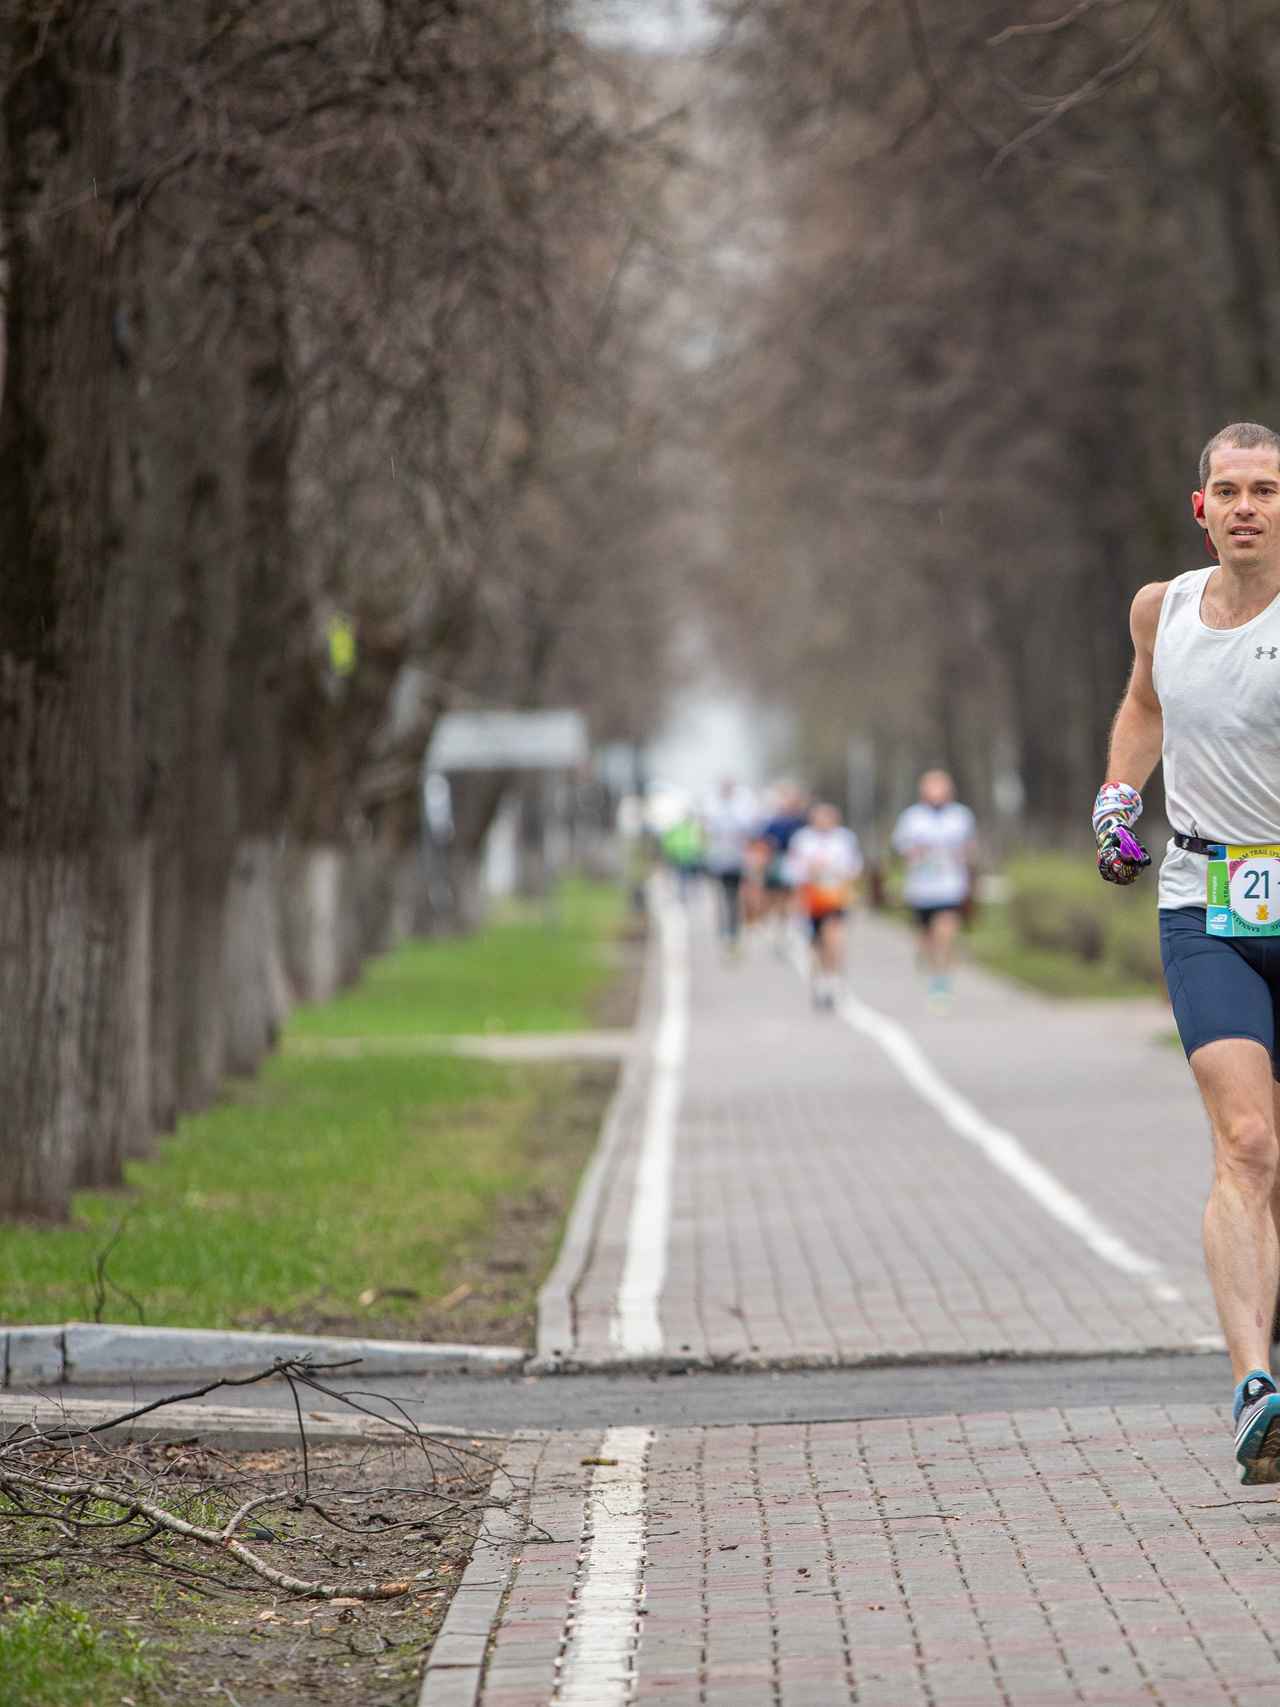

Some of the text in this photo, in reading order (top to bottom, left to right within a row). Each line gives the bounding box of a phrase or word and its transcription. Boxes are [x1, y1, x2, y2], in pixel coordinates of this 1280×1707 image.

[1230, 853, 1249, 871] DREAM
[1250, 849, 1267, 857] TRAIL
[1223, 881, 1231, 899] TRAIL
[1244, 870, 1269, 899] 21
